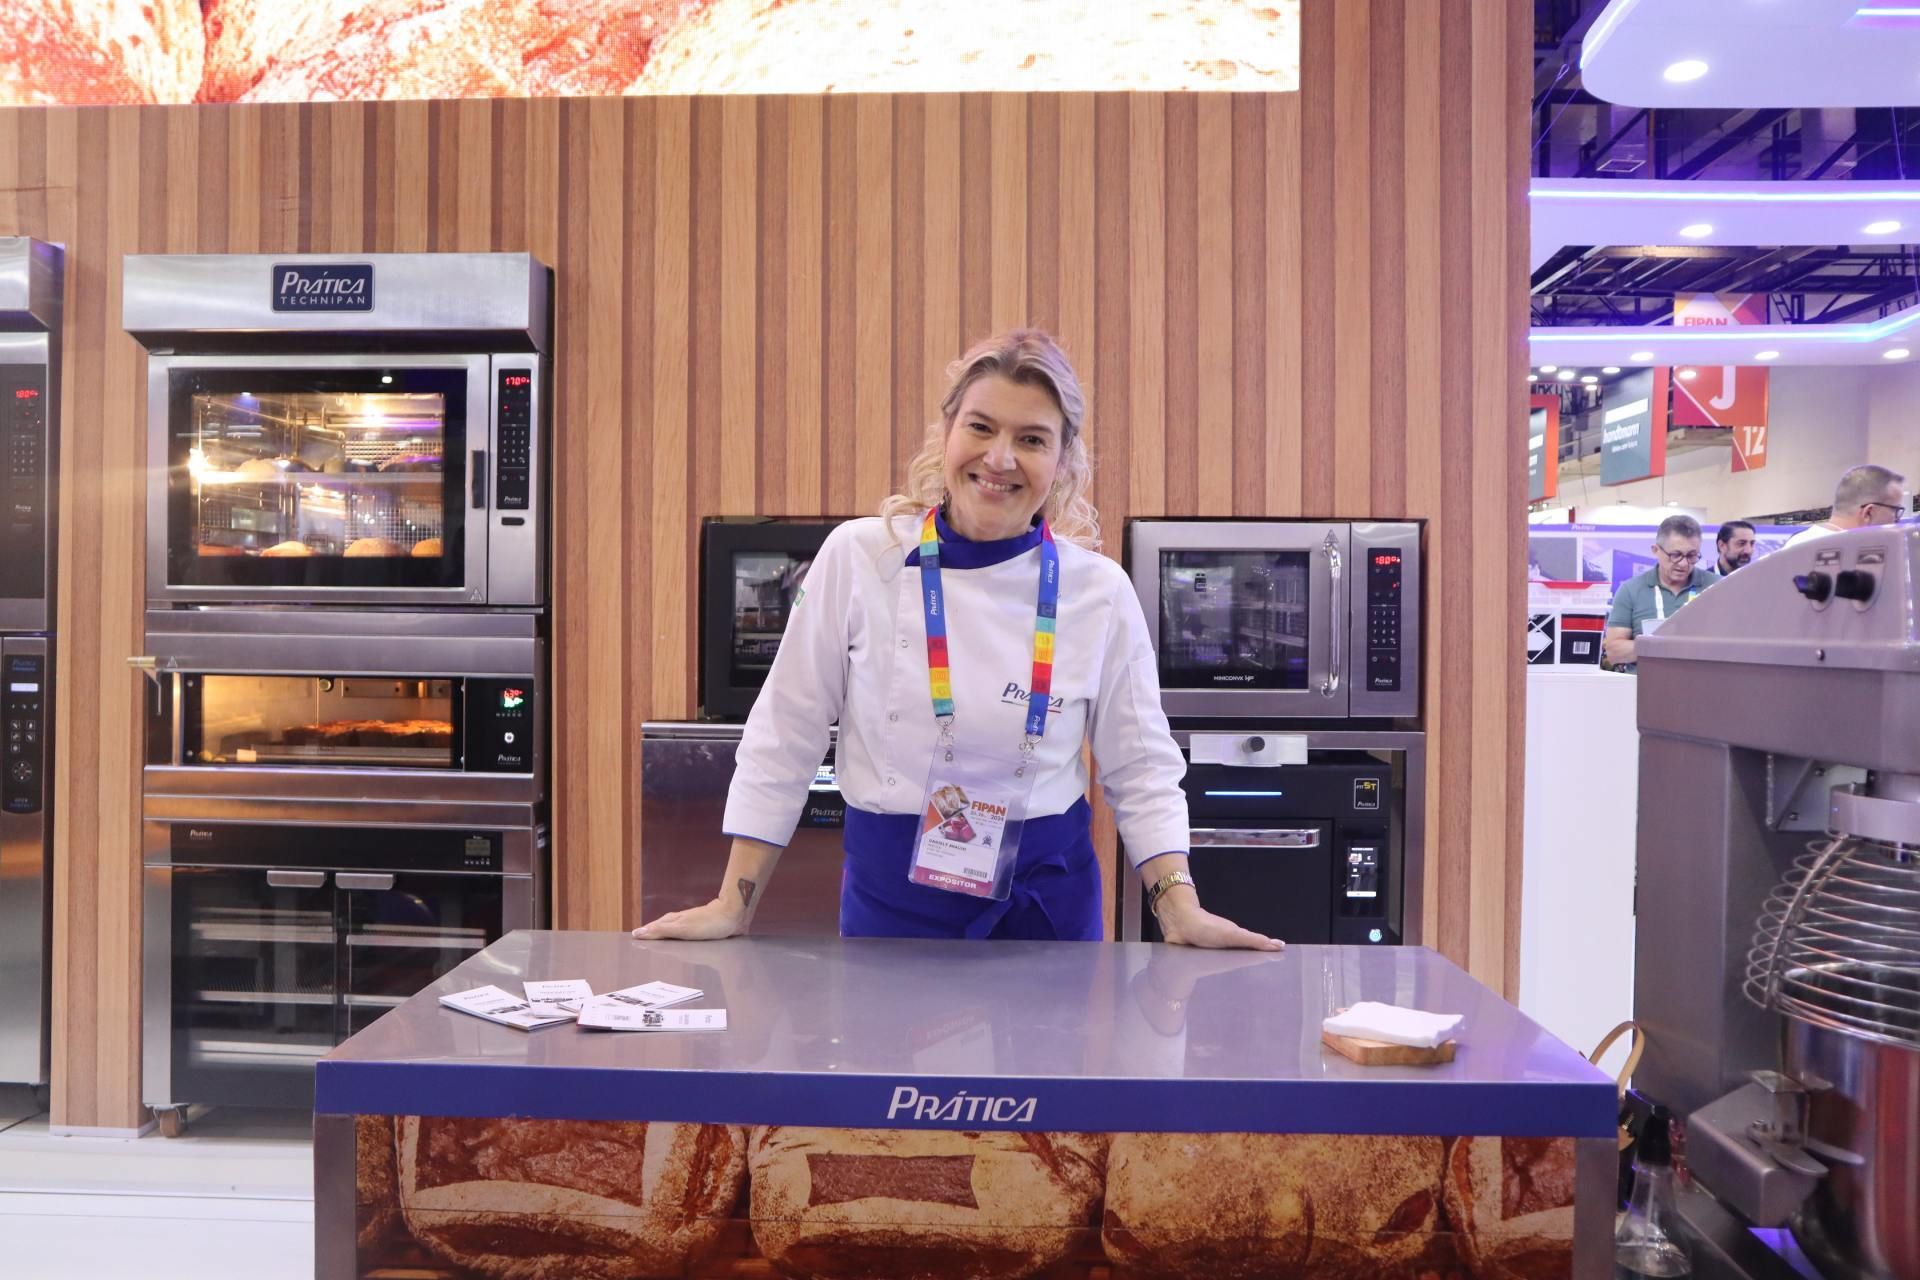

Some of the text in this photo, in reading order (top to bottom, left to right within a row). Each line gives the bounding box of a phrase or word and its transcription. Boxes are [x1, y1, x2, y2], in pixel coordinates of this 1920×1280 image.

[281, 271, 365, 294] PRÁTICA
[281, 296, 365, 304] TECHNIPAN
[1709, 366, 1736, 410] J
[1744, 427, 1765, 456] 12
[971, 800, 1006, 817] FIPAN
[928, 874, 977, 889] EXPOSITOR
[887, 1086, 1038, 1122] PRÁTICA
